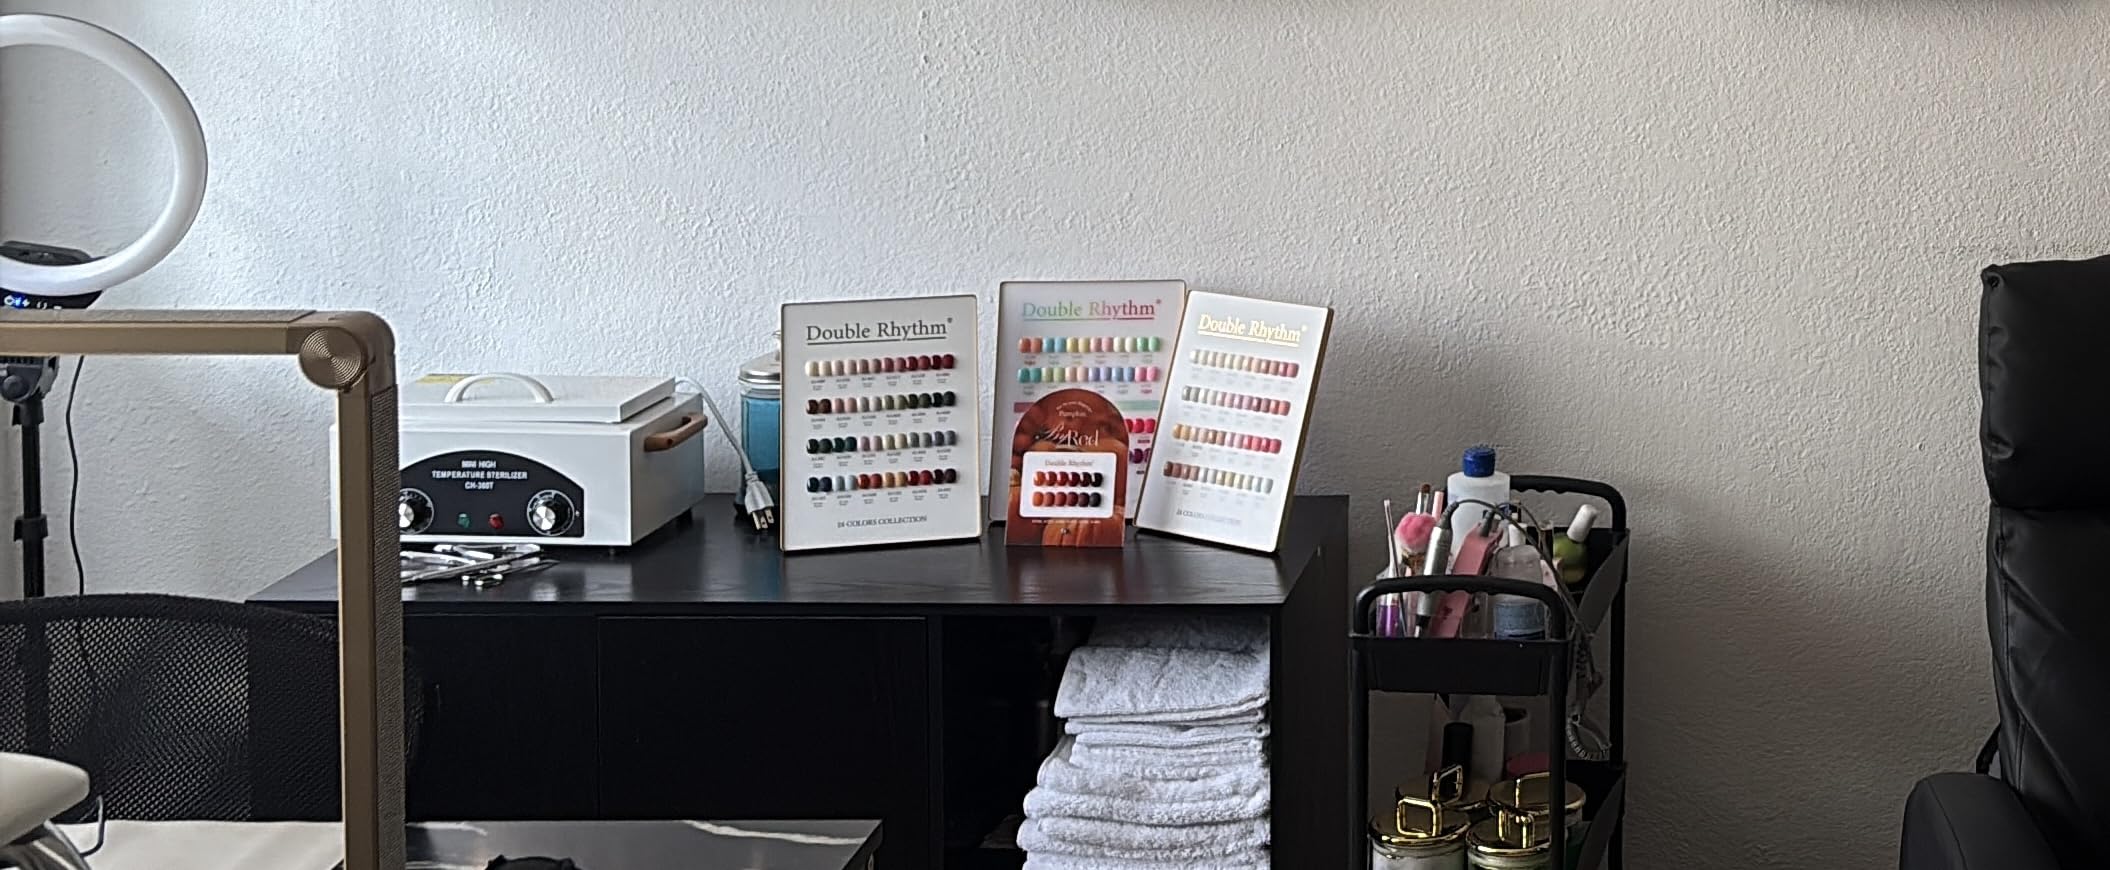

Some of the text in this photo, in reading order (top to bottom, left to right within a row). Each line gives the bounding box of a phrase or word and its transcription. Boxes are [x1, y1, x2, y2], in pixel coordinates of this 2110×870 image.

[1021, 301, 1083, 318] Double
[1197, 314, 1246, 336] Double
[806, 324, 871, 342] Double
[478, 460, 497, 468] HIGH
[431, 470, 528, 479] TEMPERATURE STERILIZER
[846, 518, 877, 528] COLORS
[878, 515, 928, 525] COLLECTION
